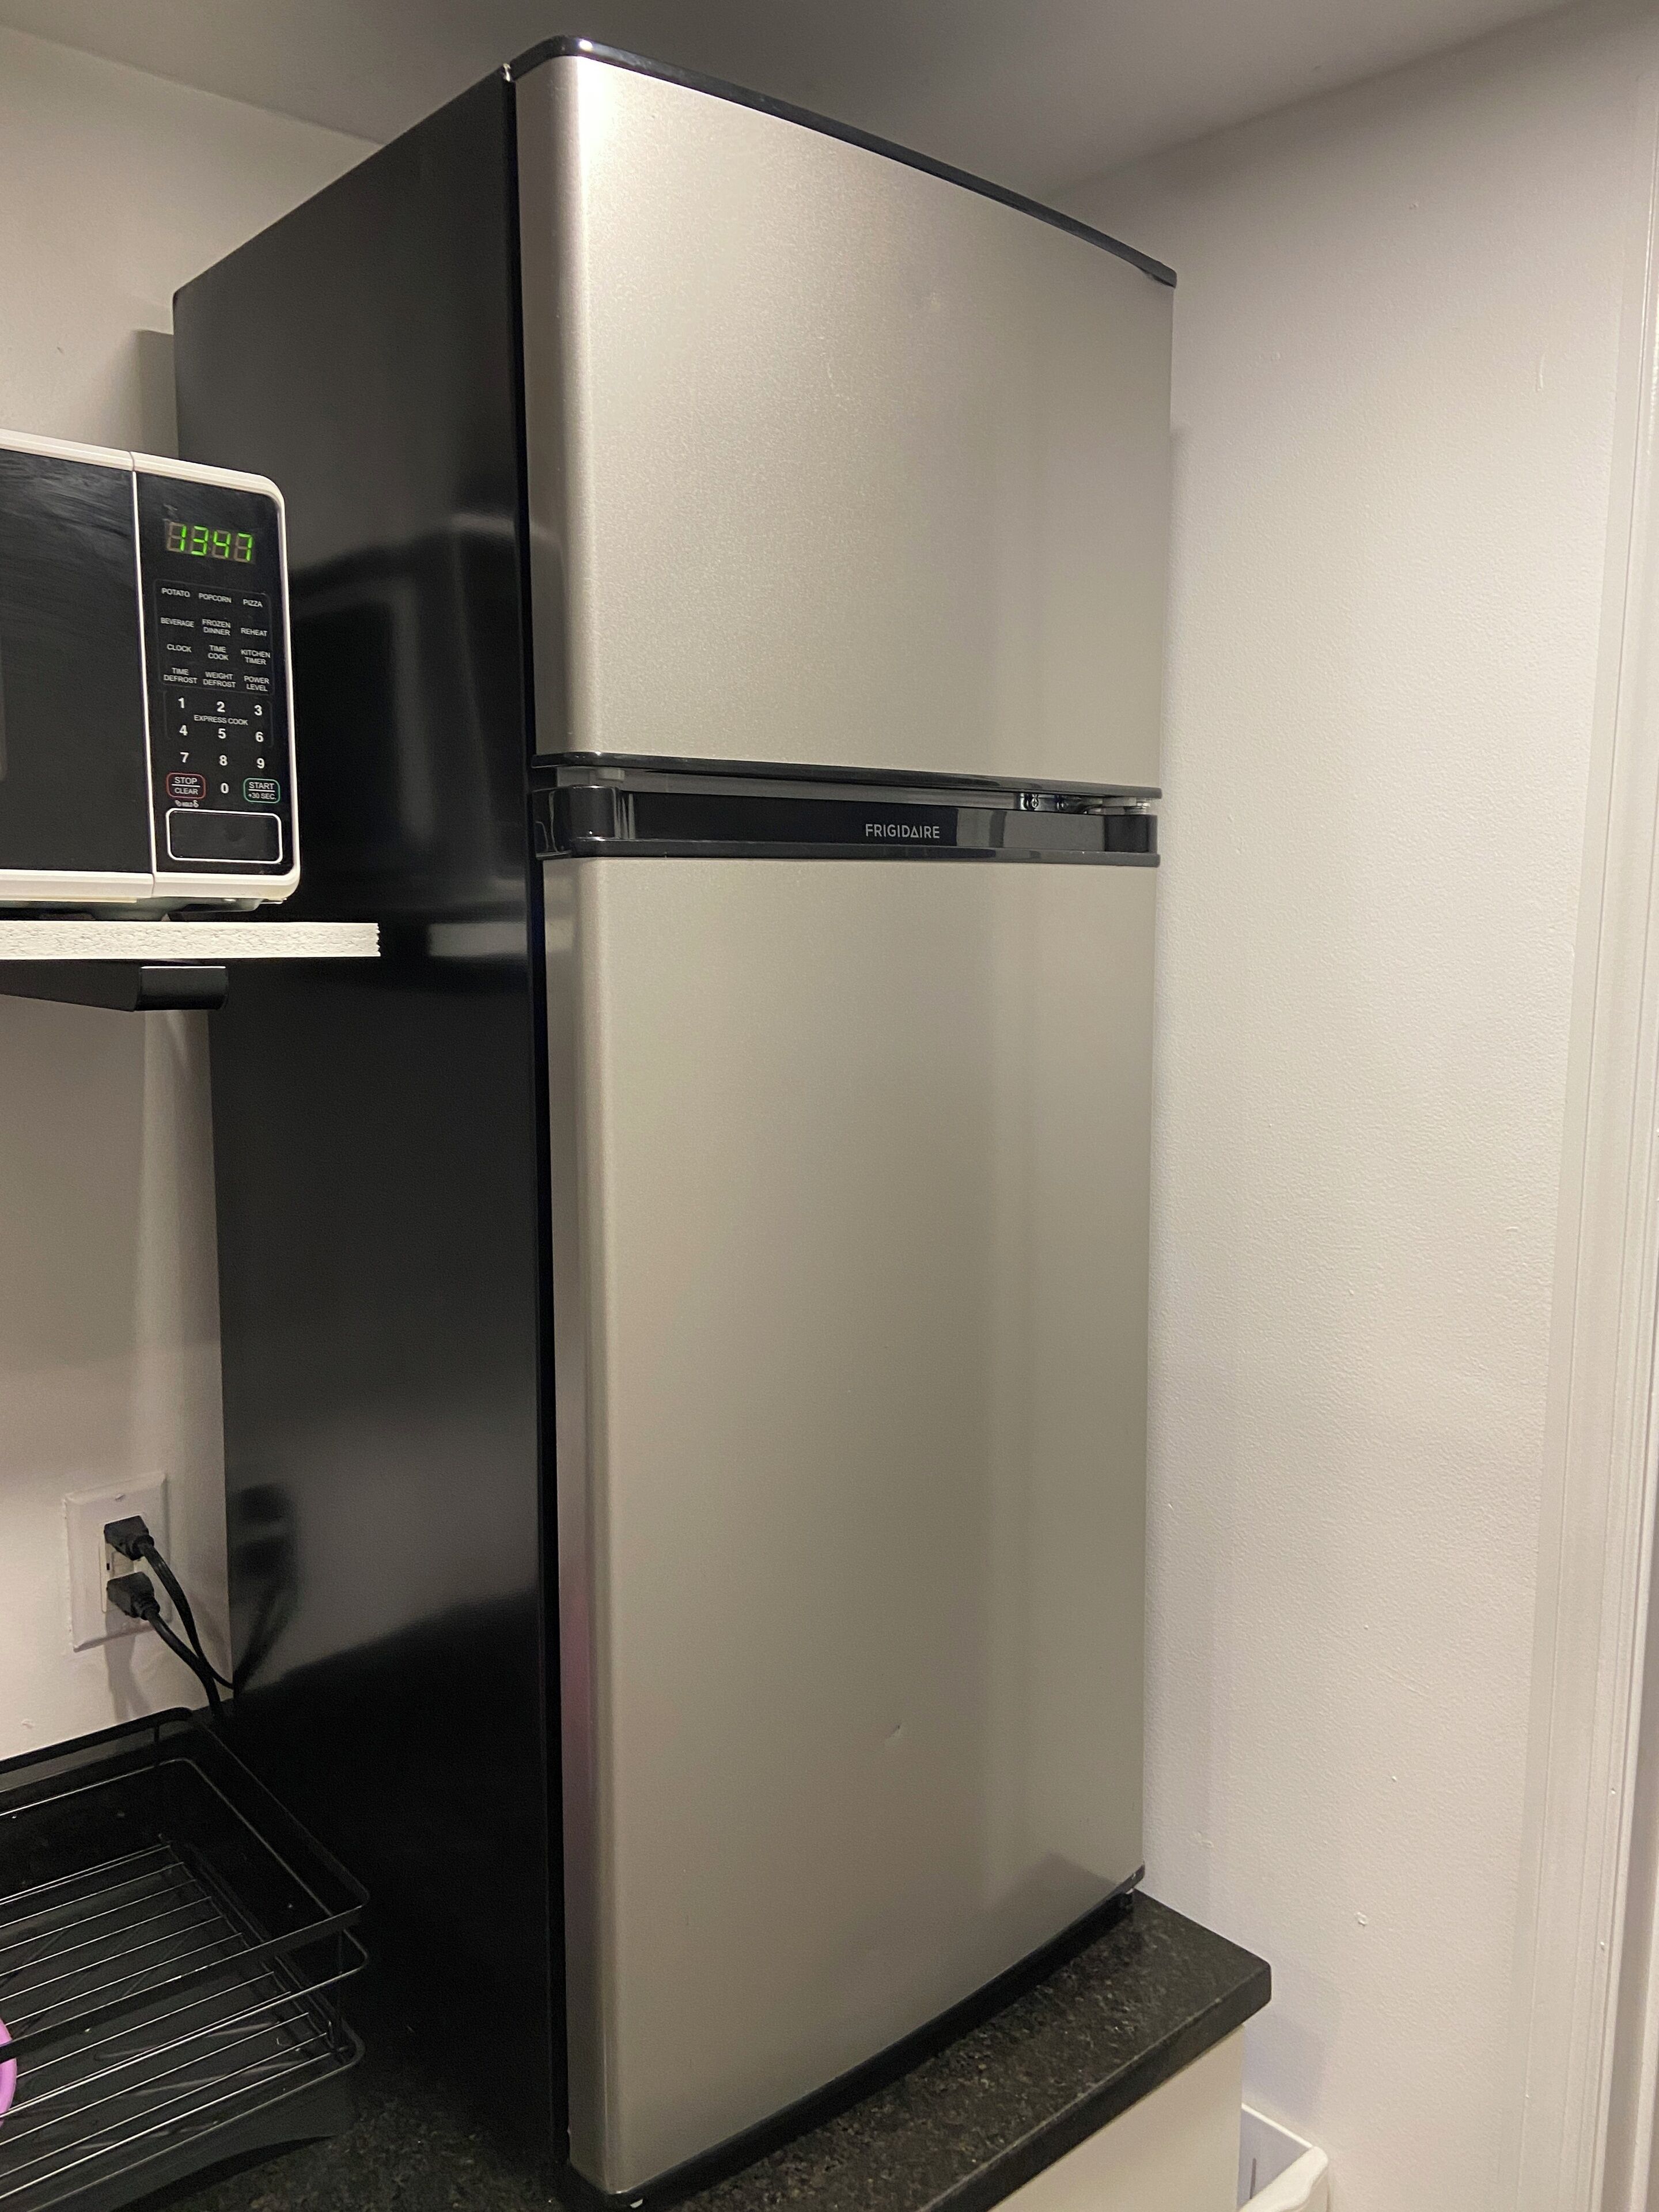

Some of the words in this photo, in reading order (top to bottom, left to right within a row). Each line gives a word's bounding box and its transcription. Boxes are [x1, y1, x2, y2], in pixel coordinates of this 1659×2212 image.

[180, 525, 254, 562] 1347
[161, 588, 190, 597] POTATO
[199, 593, 232, 603] POPCORN
[243, 599, 263, 608] PIZZA
[161, 617, 194, 628] BEVERAGE
[202, 619, 231, 628] FROZEN
[203, 627, 230, 636] DINNER
[241, 627, 268, 637] REHEAT
[166, 643, 192, 653] CLOCK
[209, 645, 226, 653] TIME
[207, 653, 229, 661] COOK
[241, 649, 271, 658] KITCHEN
[245, 657, 266, 665] TIMER
[172, 667, 189, 675] TIME
[205, 671, 233, 680] WEIGHT
[163, 674, 198, 684] DEFROST
[203, 679, 236, 688] DEFROST
[244, 675, 270, 684] POWER
[246, 683, 268, 692] LEVEL
[178, 697, 185, 709] 1
[217, 701, 225, 713] 2
[254, 704, 263, 716] 3
[194, 714, 227, 724] EXPRESS
[229, 717, 248, 725] COOK
[179, 725, 188, 736] 4
[218, 728, 226, 739] 5
[256, 731, 264, 743] 6
[180, 752, 189, 763] 7
[219, 755, 228, 766] 8
[256, 757, 265, 769] 9
[175, 777, 198, 785] STOP
[248, 782, 274, 790] START
[175, 787, 198, 796] CLEAR
[220, 783, 229, 794] 0
[865, 823, 940, 839] FRIGIDAIRE
